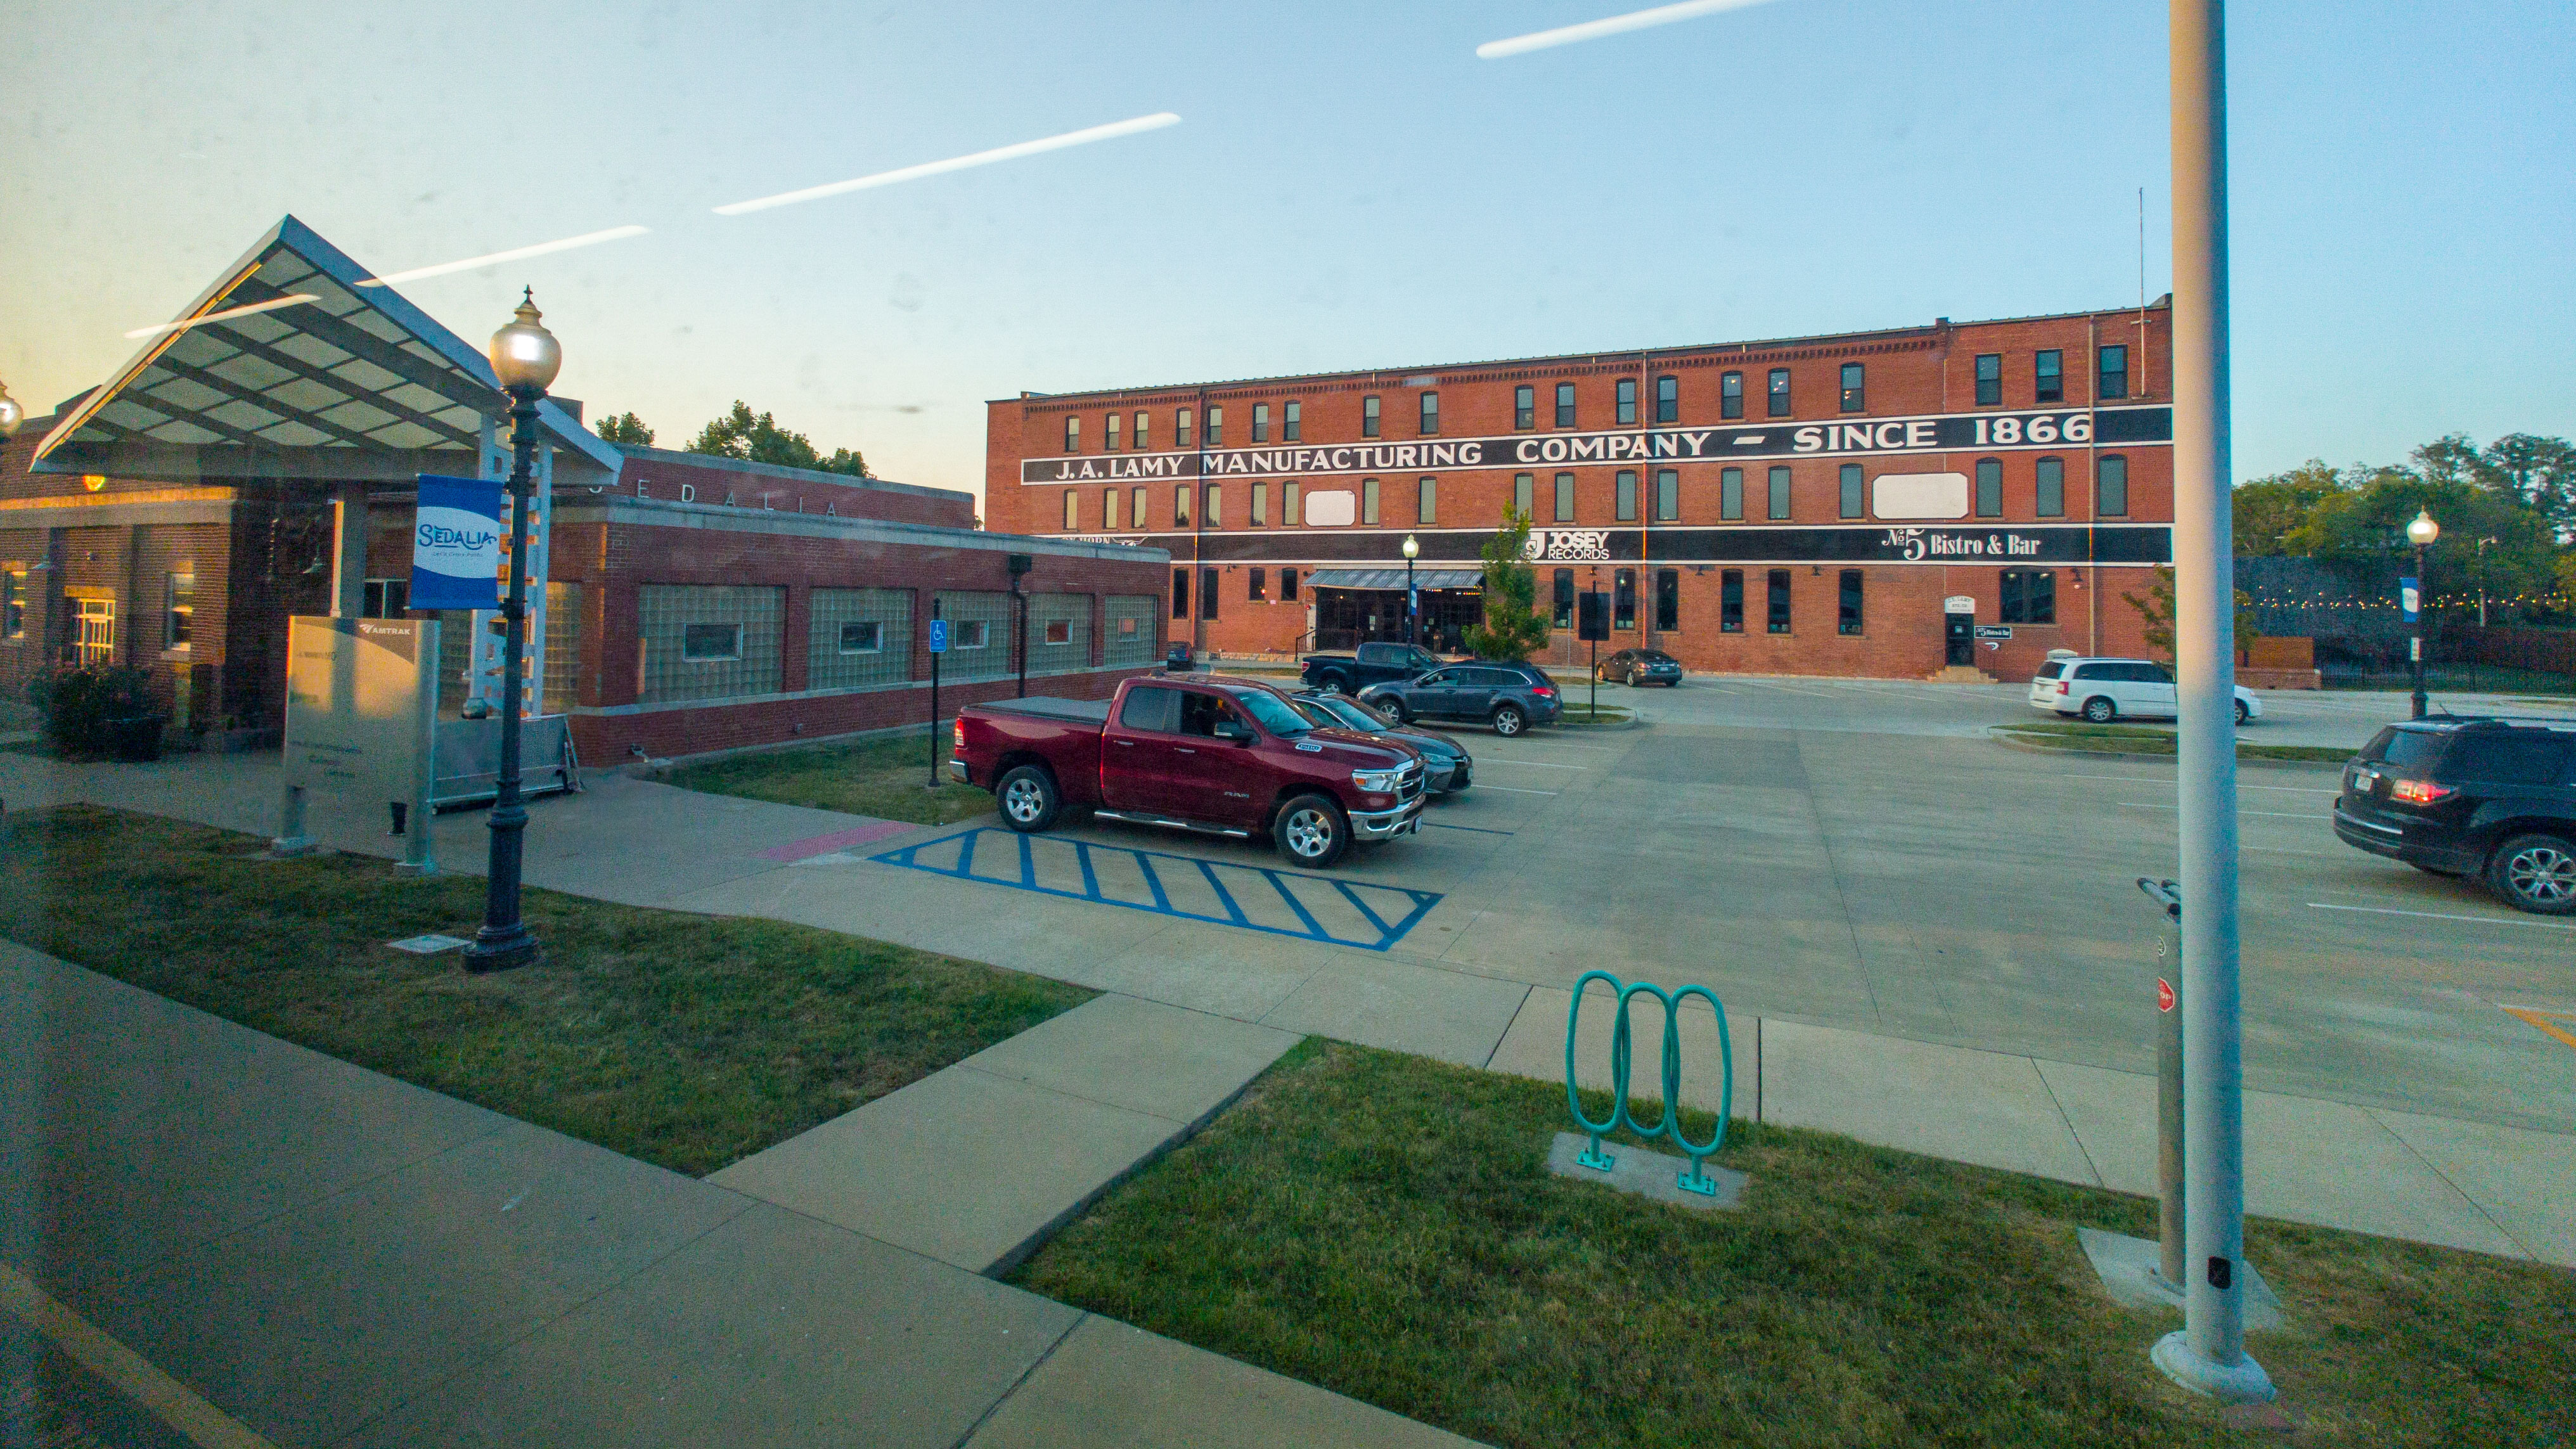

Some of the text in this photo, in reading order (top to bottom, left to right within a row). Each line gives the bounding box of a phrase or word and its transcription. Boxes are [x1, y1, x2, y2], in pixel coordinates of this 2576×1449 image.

[1110, 456, 1185, 478] LAMY
[1203, 442, 1482, 473] MANUFACTURING
[1516, 432, 1711, 462] COMPANY
[1793, 422, 1938, 452] SINCE
[1975, 414, 2090, 444] 1866
[1549, 532, 1610, 549] JOSEY
[1931, 534, 1983, 555] Bistro
[1987, 534, 2004, 555] &
[2008, 534, 2042, 555] Bar
[1548, 548, 1610, 560] RECORDS
